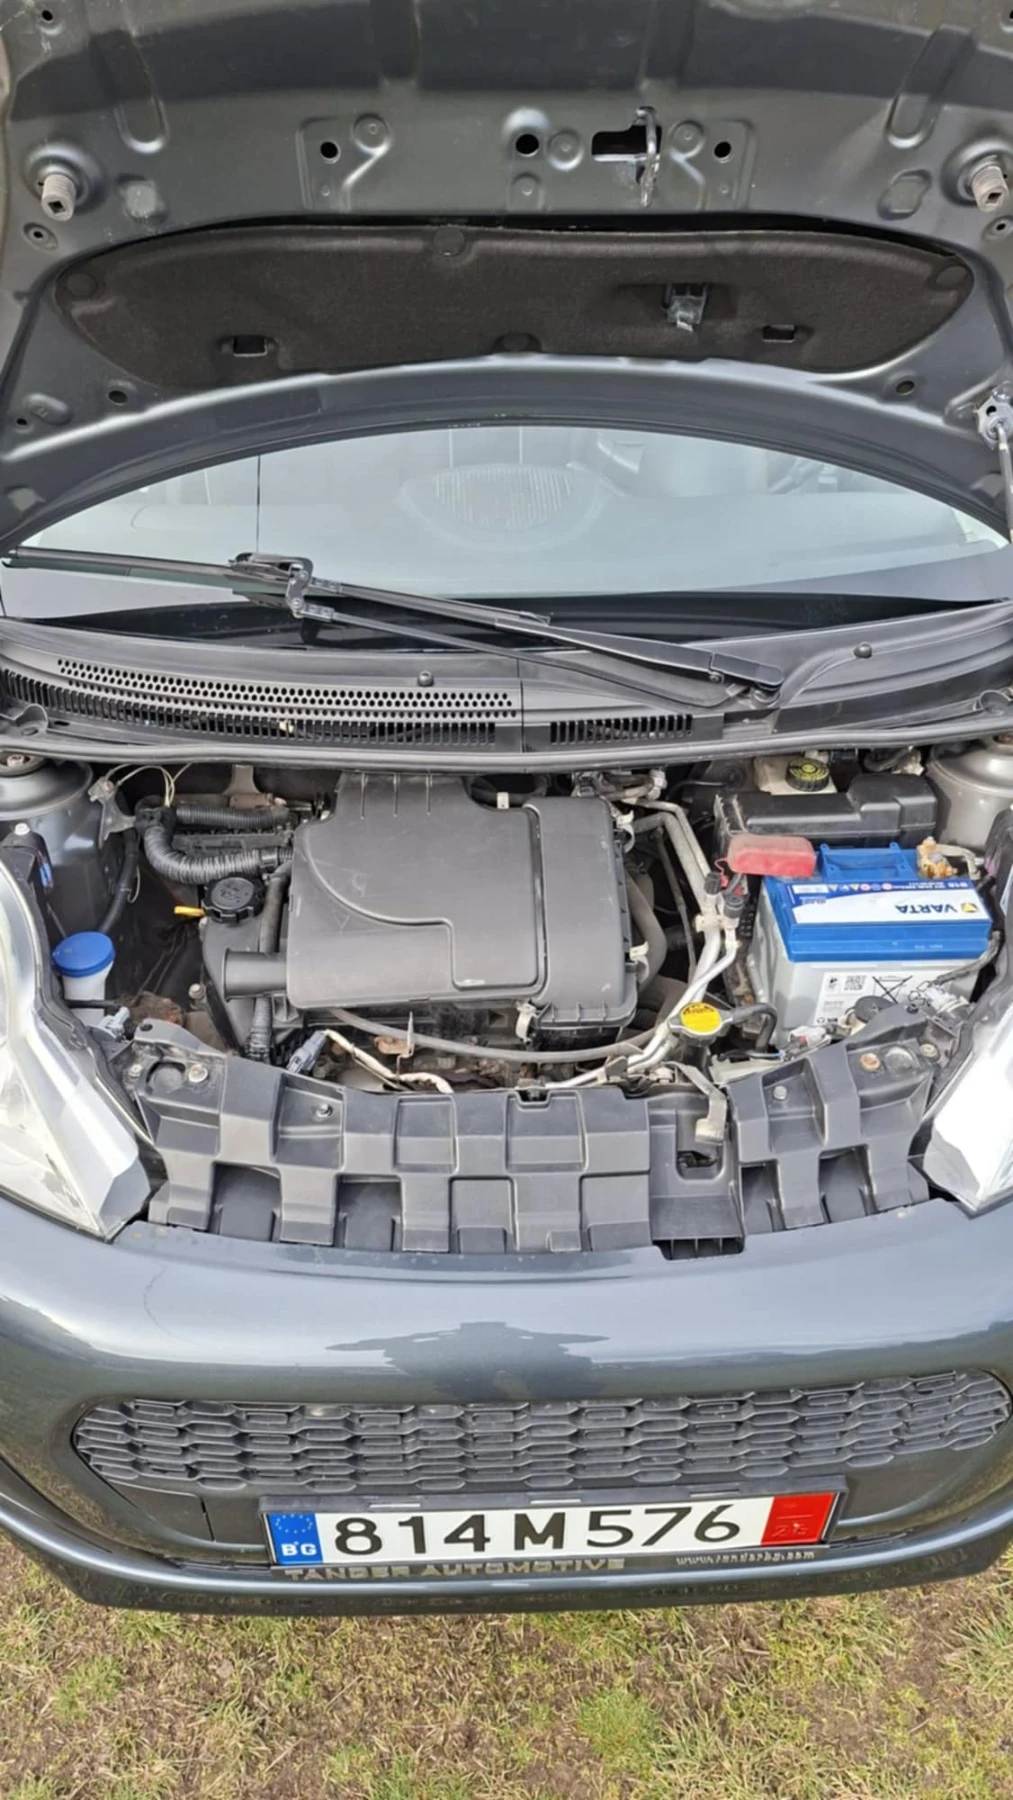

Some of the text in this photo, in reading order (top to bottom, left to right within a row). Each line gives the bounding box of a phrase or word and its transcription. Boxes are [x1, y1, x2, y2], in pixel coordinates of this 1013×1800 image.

[894, 903, 957, 914] VARTA
[333, 1504, 741, 1555] 814 M 576
[281, 1542, 317, 1556] BG
[420, 1557, 626, 1576] AUTOMOTIVE
